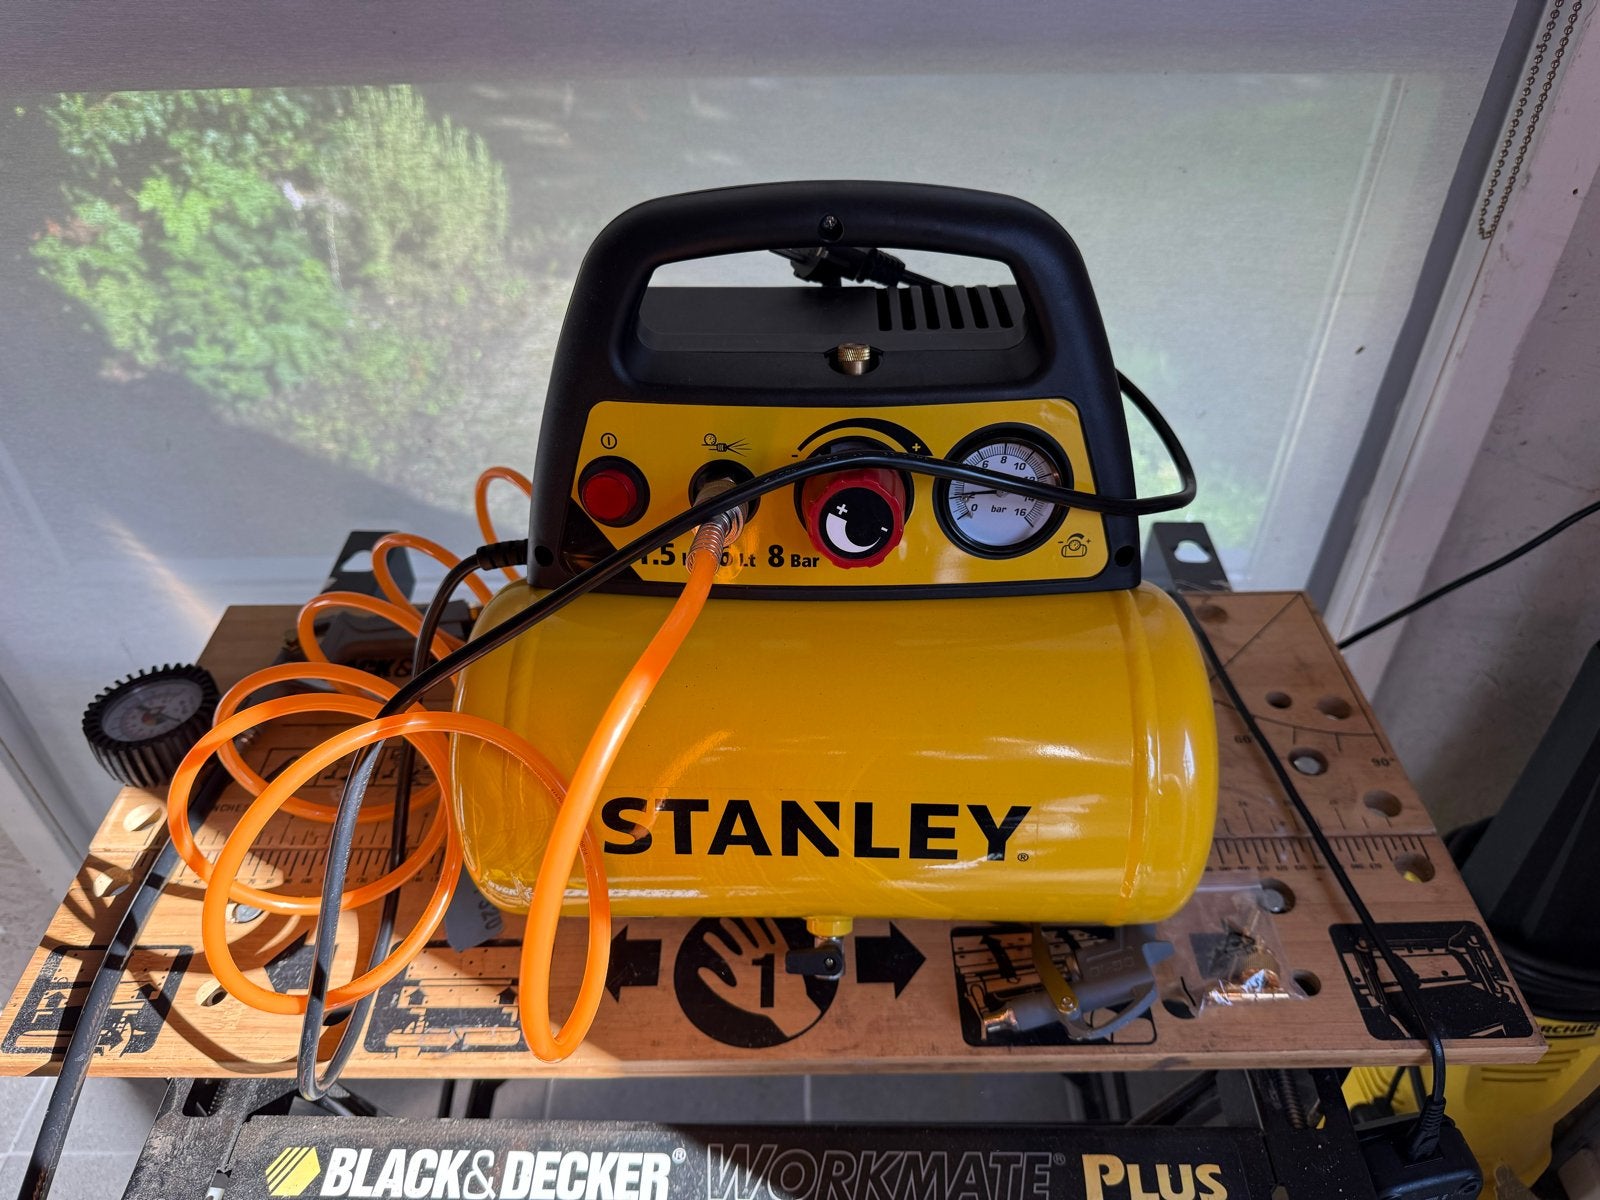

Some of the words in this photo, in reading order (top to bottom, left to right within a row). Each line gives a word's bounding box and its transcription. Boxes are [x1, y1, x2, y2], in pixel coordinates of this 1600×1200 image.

[982, 460, 989, 469] 6
[1000, 456, 1008, 465] 8
[1013, 462, 1026, 471] 10
[970, 503, 978, 512] 0
[990, 505, 1007, 513] bar
[1014, 508, 1027, 517] 16
[767, 544, 785, 568] 8
[790, 554, 820, 568] Bar
[600, 796, 1032, 861] STANLEY
[752, 953, 775, 1008] 1
[1540, 1023, 1600, 1034] RCHER
[706, 1143, 1054, 1200] WORKMATE
[1081, 1154, 1229, 1200] PLUS
